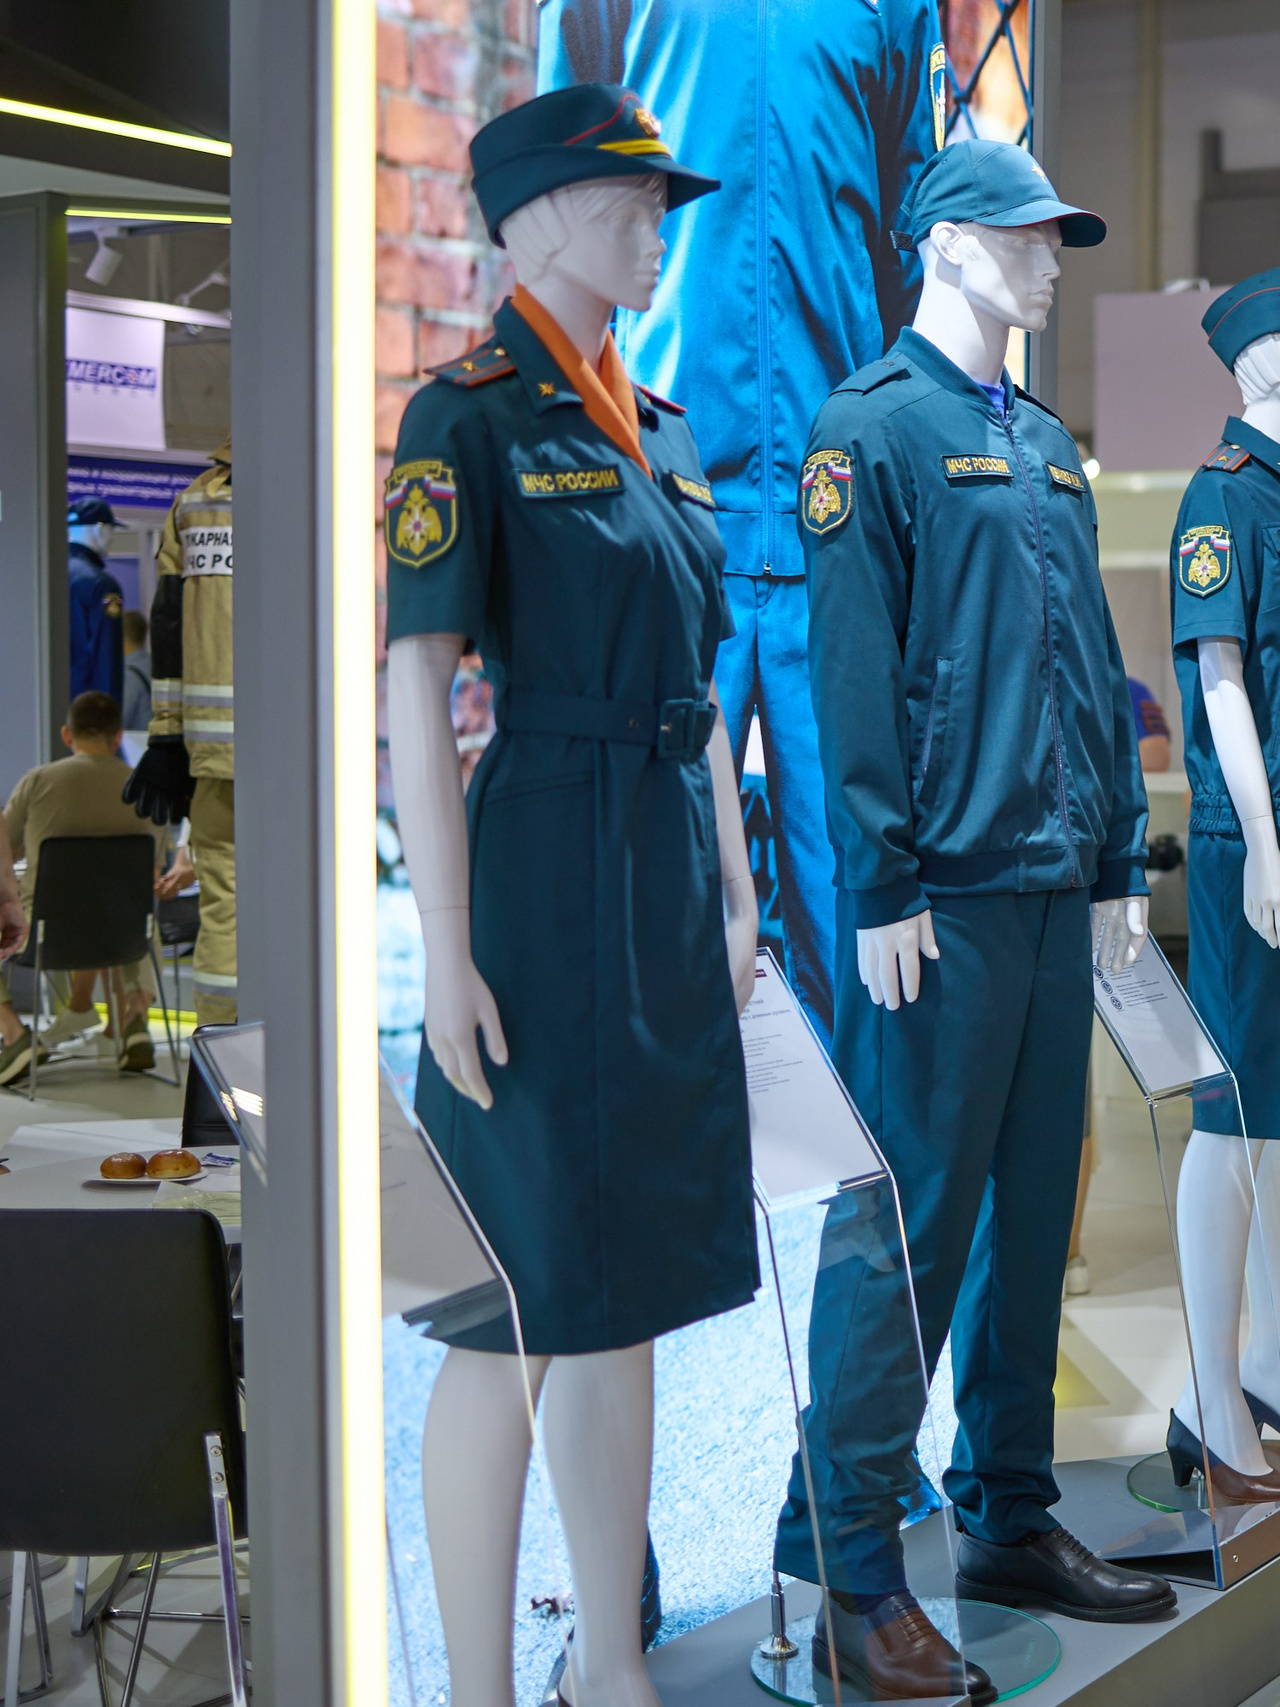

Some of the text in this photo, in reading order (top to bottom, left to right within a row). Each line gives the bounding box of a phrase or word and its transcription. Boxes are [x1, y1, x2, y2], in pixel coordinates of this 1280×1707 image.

[946, 457, 1010, 474] МЧС РОССИИ
[520, 469, 619, 493] МЧС РОССИИ
[187, 554, 206, 569] ЧС
